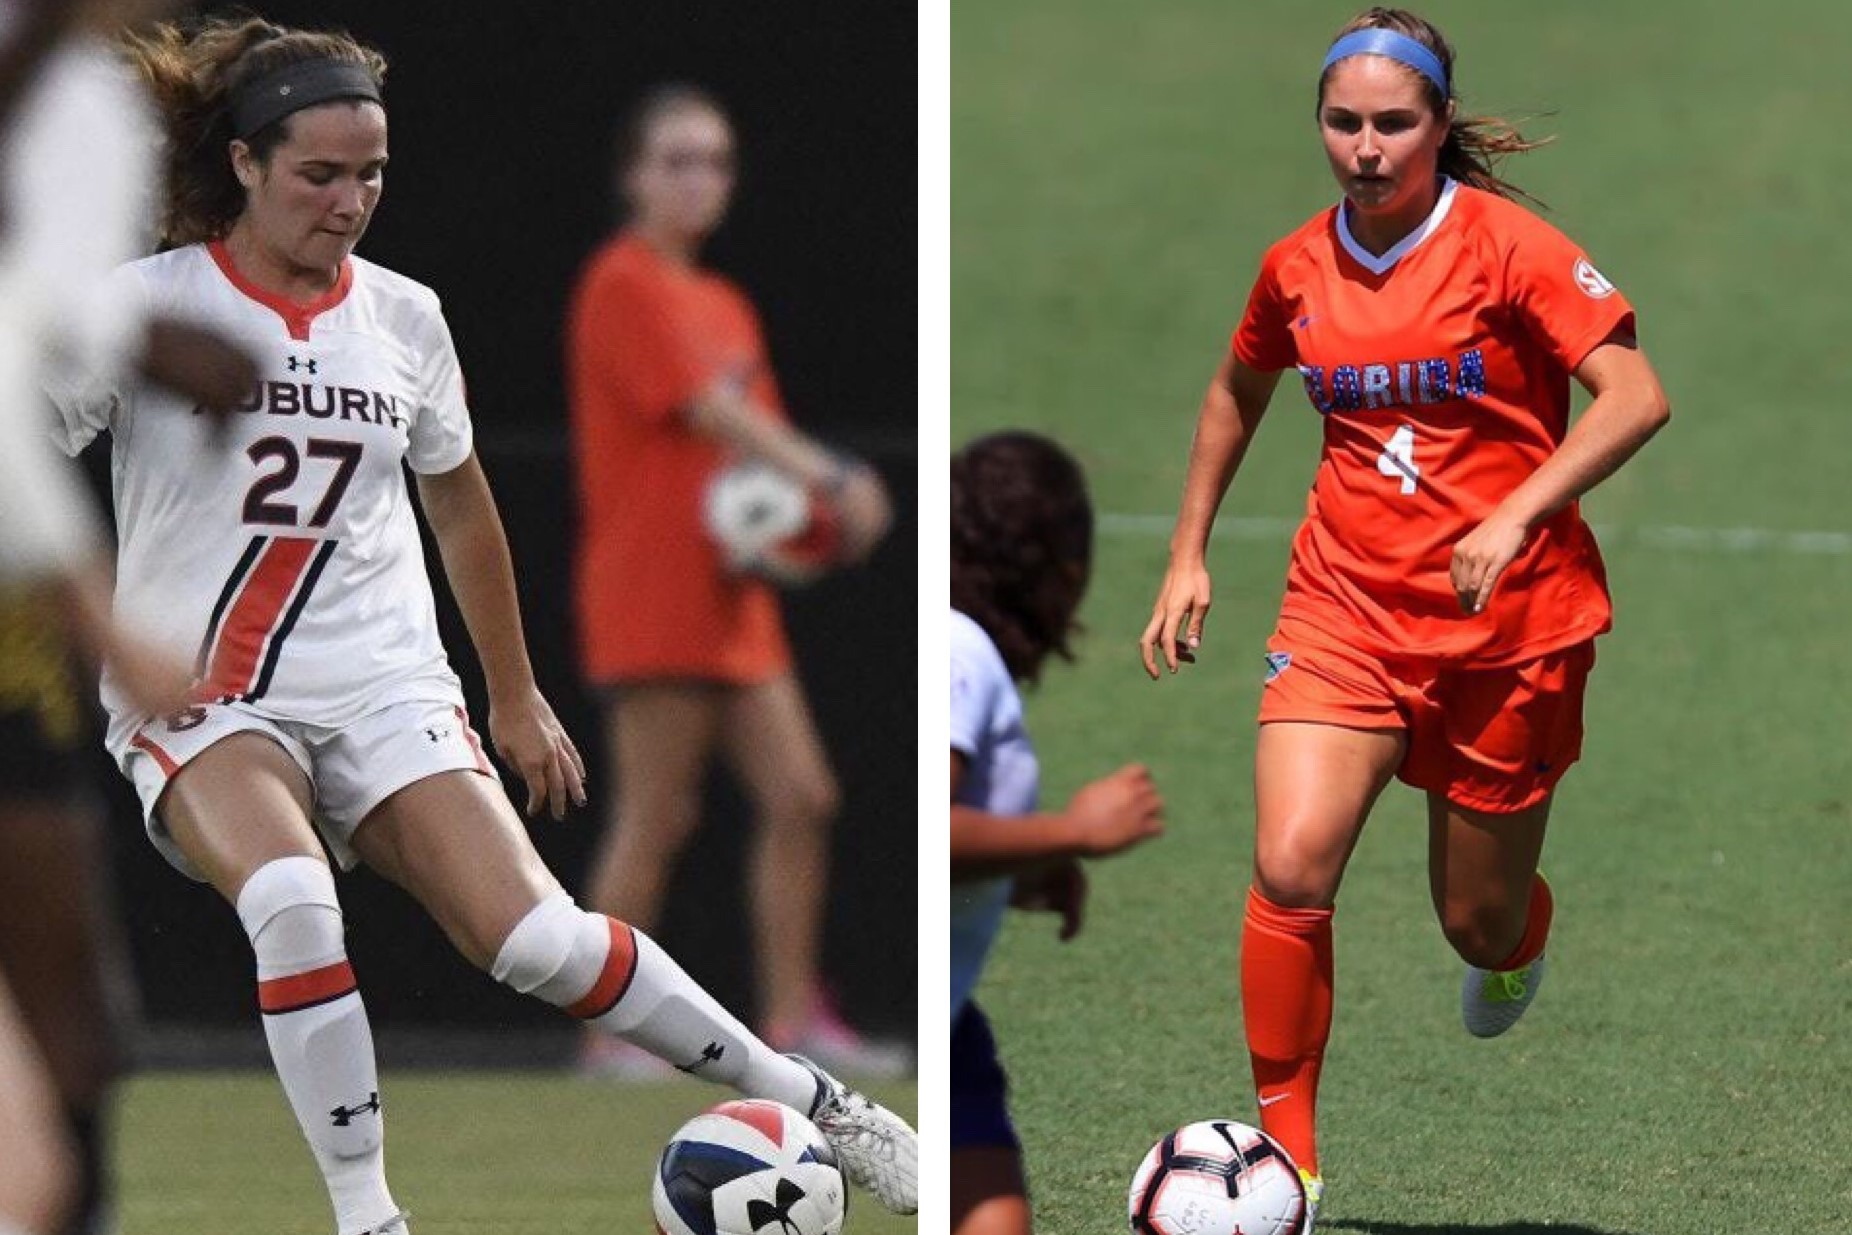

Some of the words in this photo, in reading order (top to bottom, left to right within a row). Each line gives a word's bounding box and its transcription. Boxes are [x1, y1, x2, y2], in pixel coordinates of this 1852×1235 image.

[193, 380, 401, 428] UBURN
[242, 435, 364, 528] 27
[1376, 424, 1421, 496] 4
